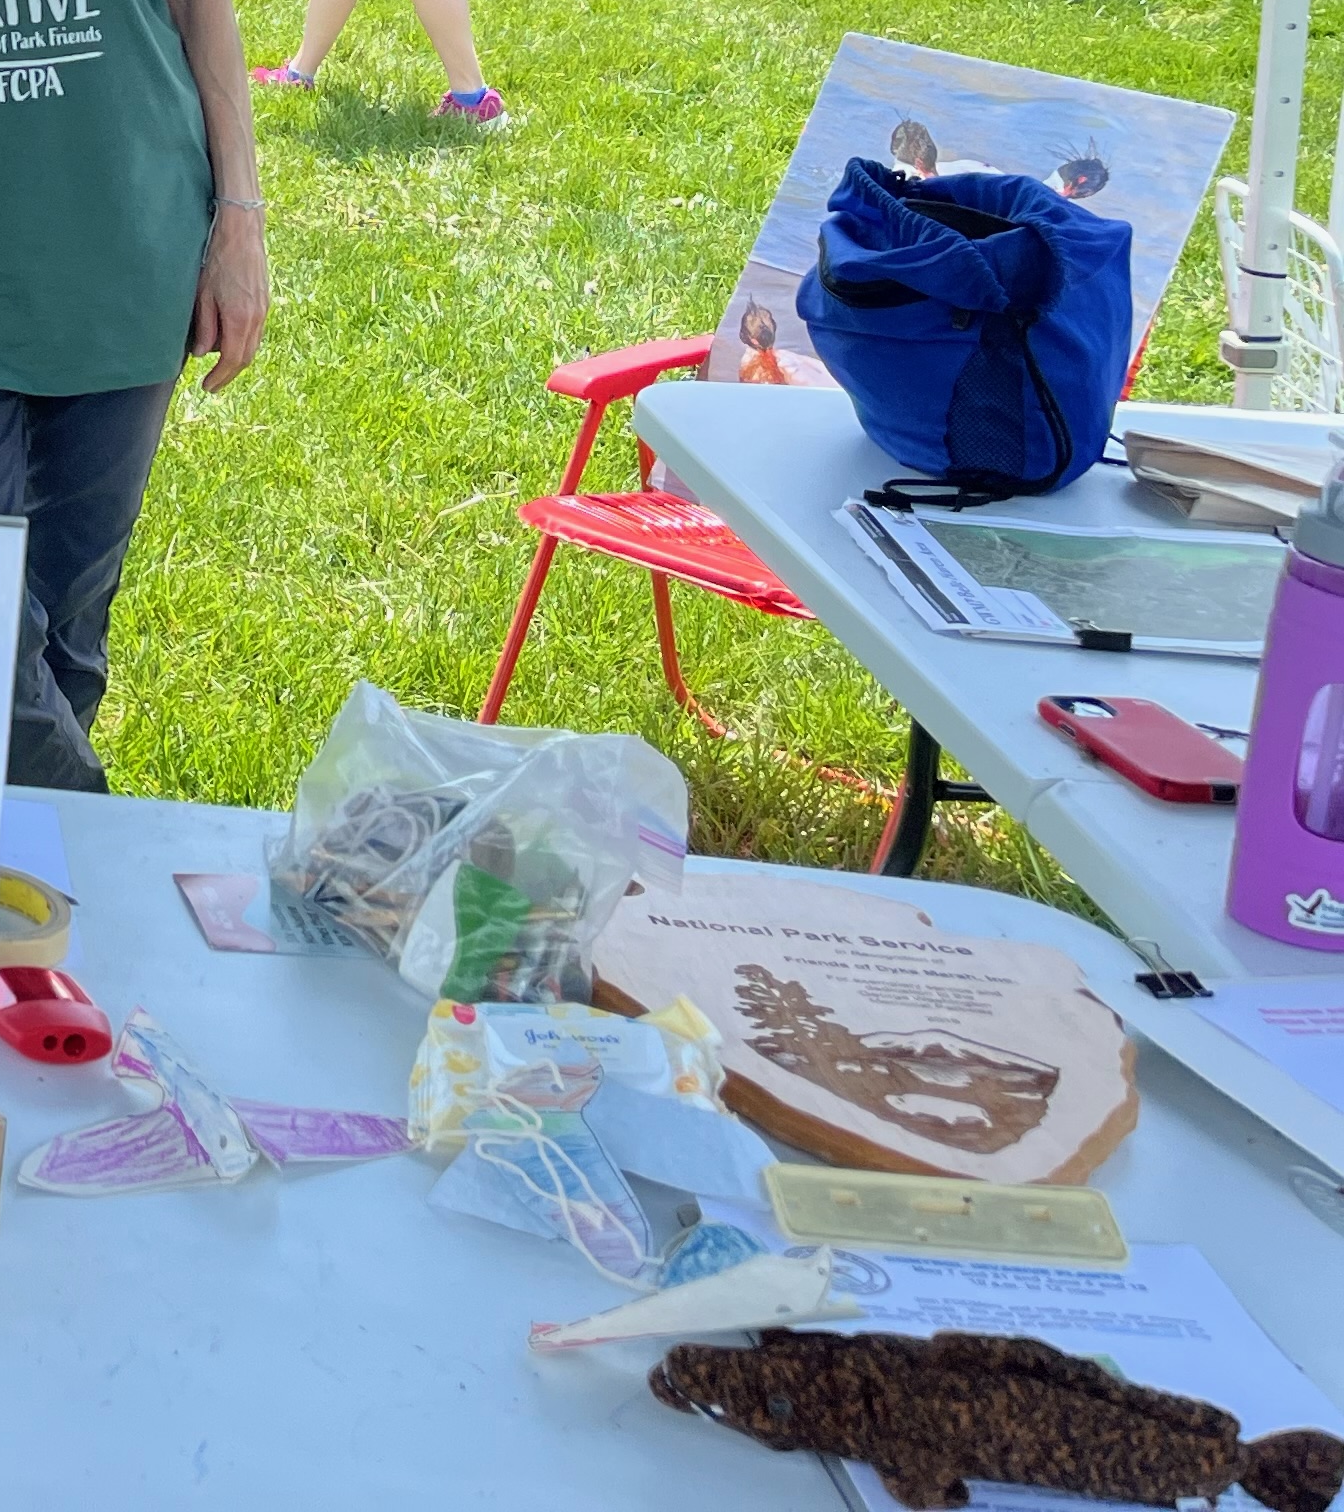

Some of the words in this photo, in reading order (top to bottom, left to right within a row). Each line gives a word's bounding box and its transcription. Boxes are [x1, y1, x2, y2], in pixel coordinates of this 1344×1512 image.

[11, 31, 46, 51] Park
[48, 25, 102, 47] Friends
[647, 914, 772, 937] National
[780, 928, 851, 945] Park
[861, 935, 973, 956] Service
[783, 955, 849, 969] Friends
[855, 961, 871, 970] of
[875, 964, 919, 976] Dyke
